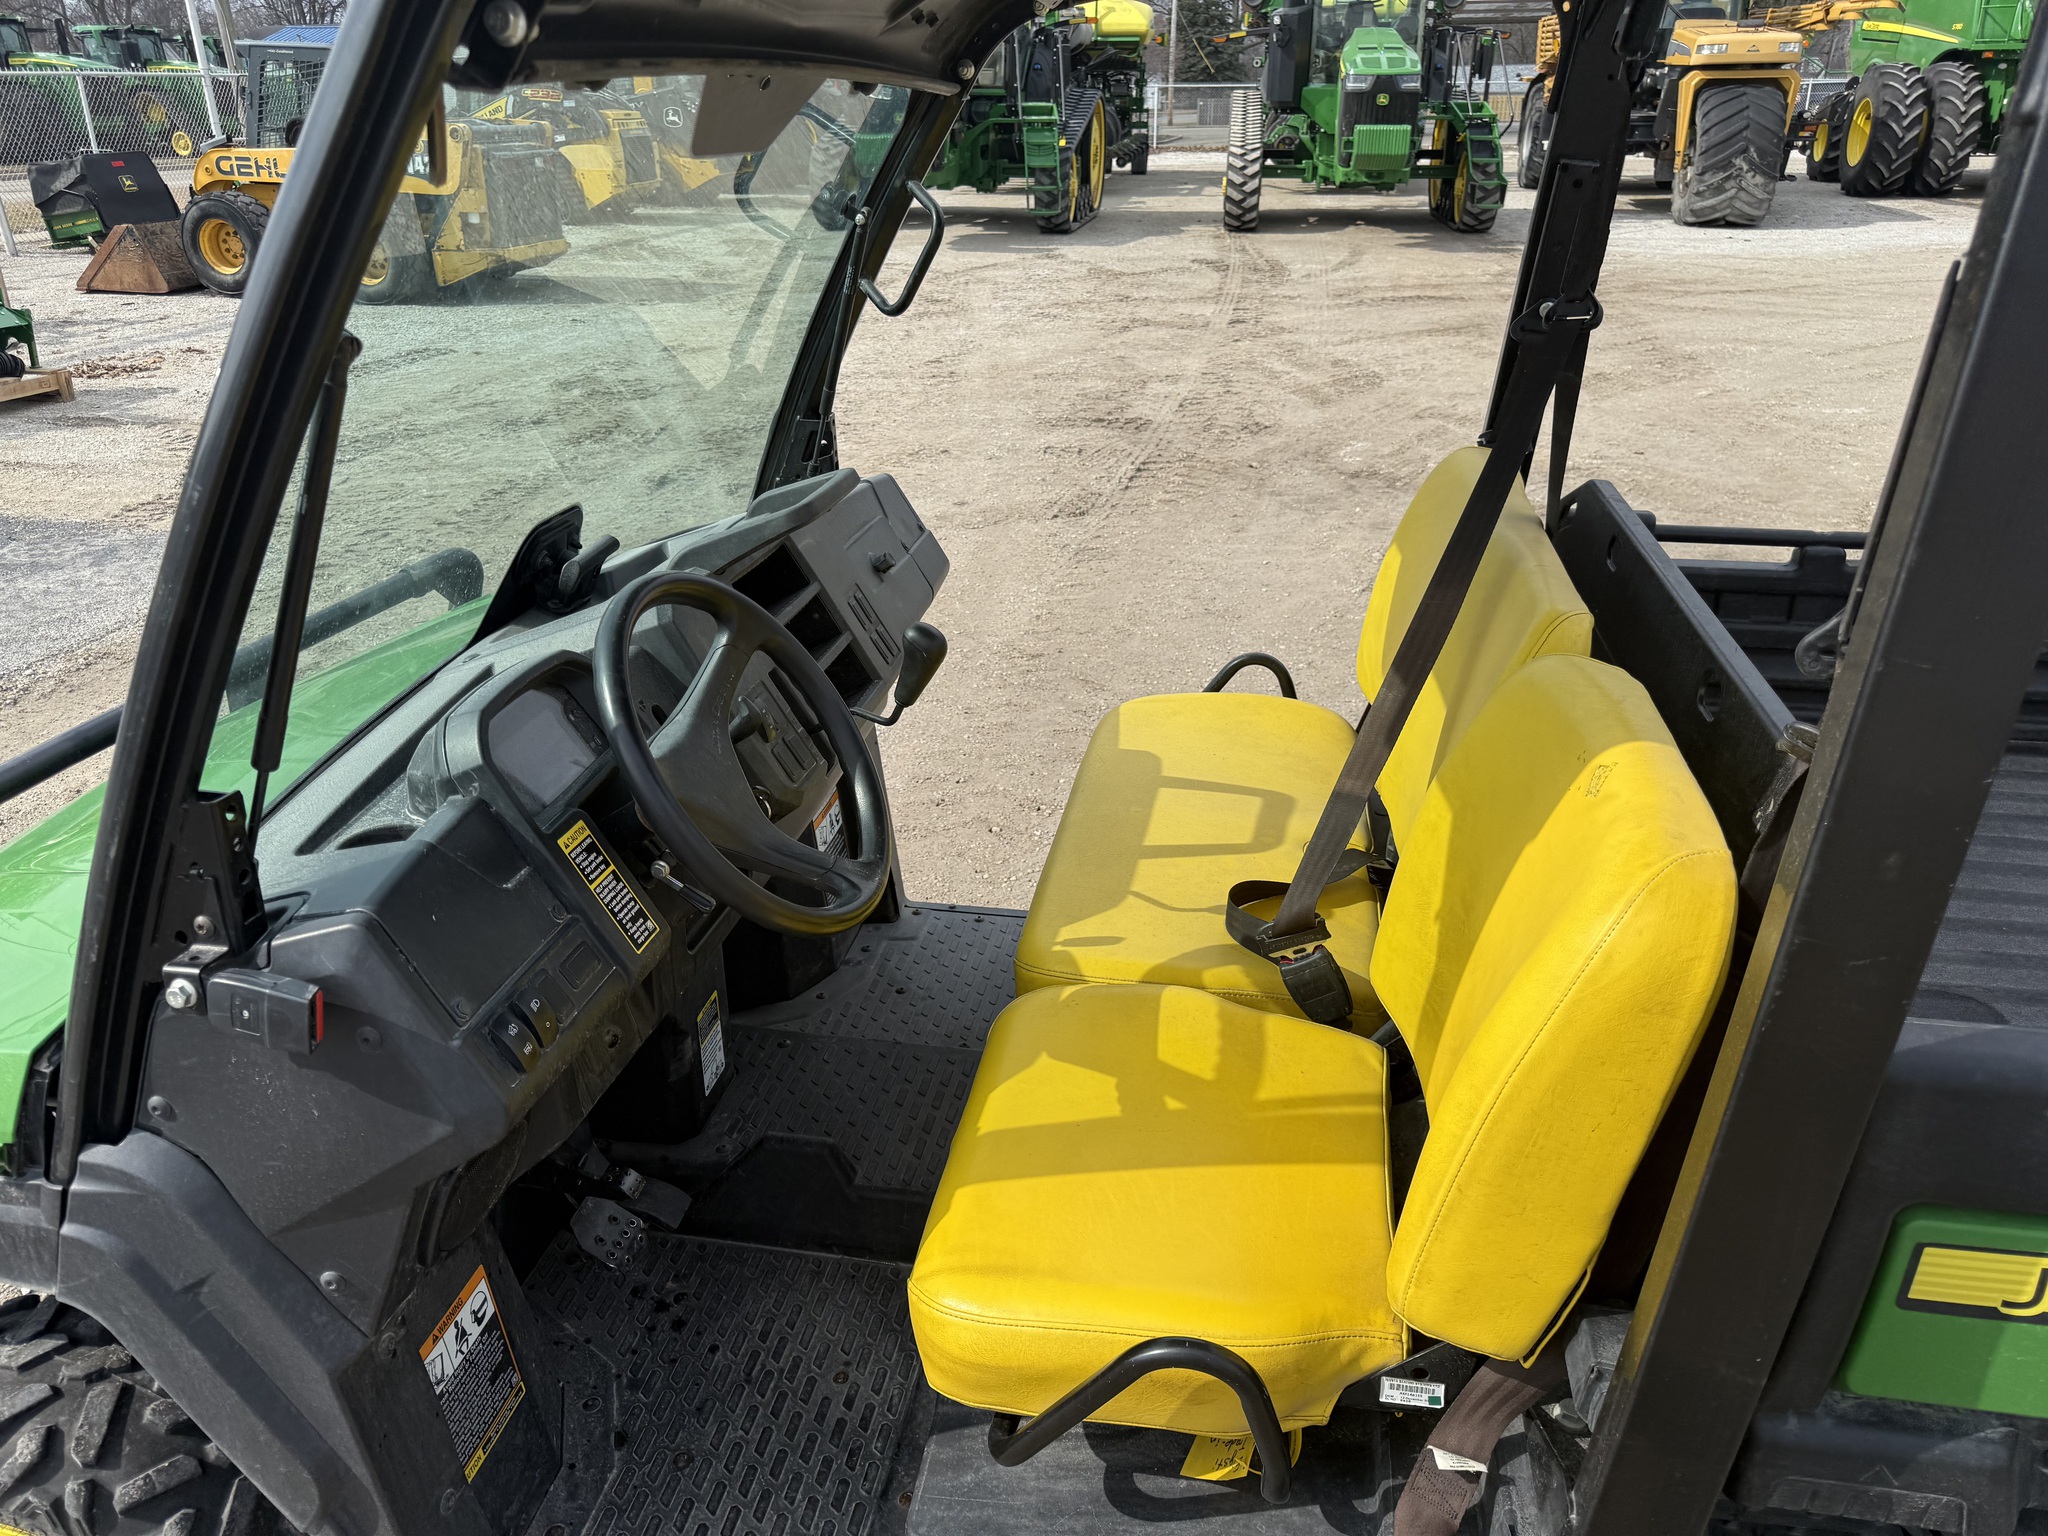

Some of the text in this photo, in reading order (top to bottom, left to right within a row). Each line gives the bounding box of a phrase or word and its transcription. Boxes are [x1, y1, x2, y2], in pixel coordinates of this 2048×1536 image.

[214, 156, 287, 178] GEHL
[567, 825, 588, 844] CAUTION
[438, 1298, 463, 1333] WARNING
[466, 1454, 482, 1479] UTION
